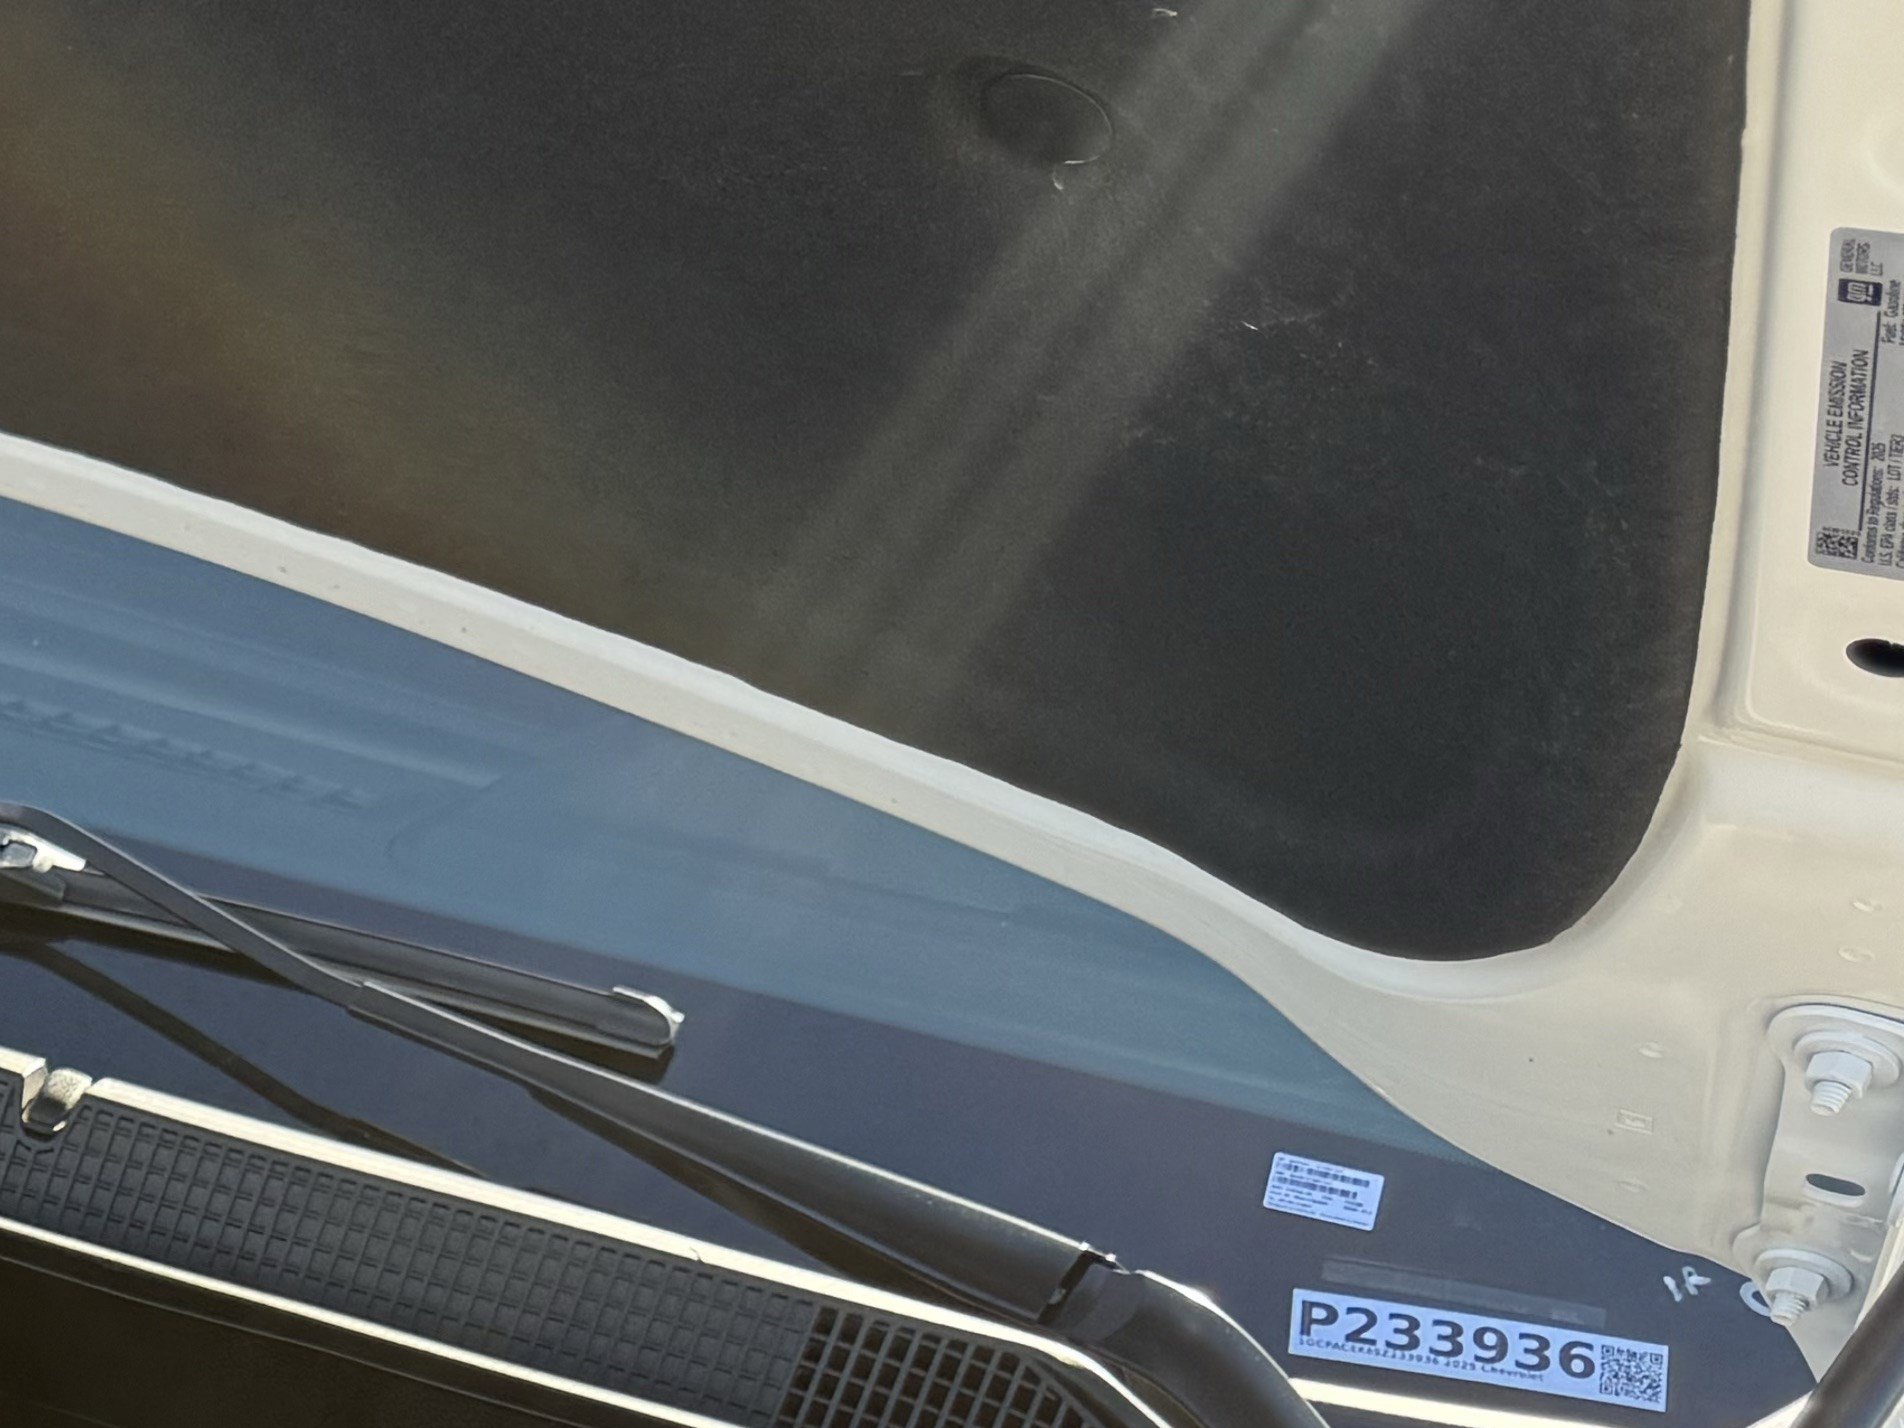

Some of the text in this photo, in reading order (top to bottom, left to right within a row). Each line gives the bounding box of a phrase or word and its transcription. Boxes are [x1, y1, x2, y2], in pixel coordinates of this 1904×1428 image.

[1824, 361, 1847, 466] VEHICLE EMISSION
[1842, 349, 1869, 486] CONTROL INFORMATION
[1300, 1299, 1596, 1380] P233936
[1481, 1362, 1545, 1383] Chevrolet
